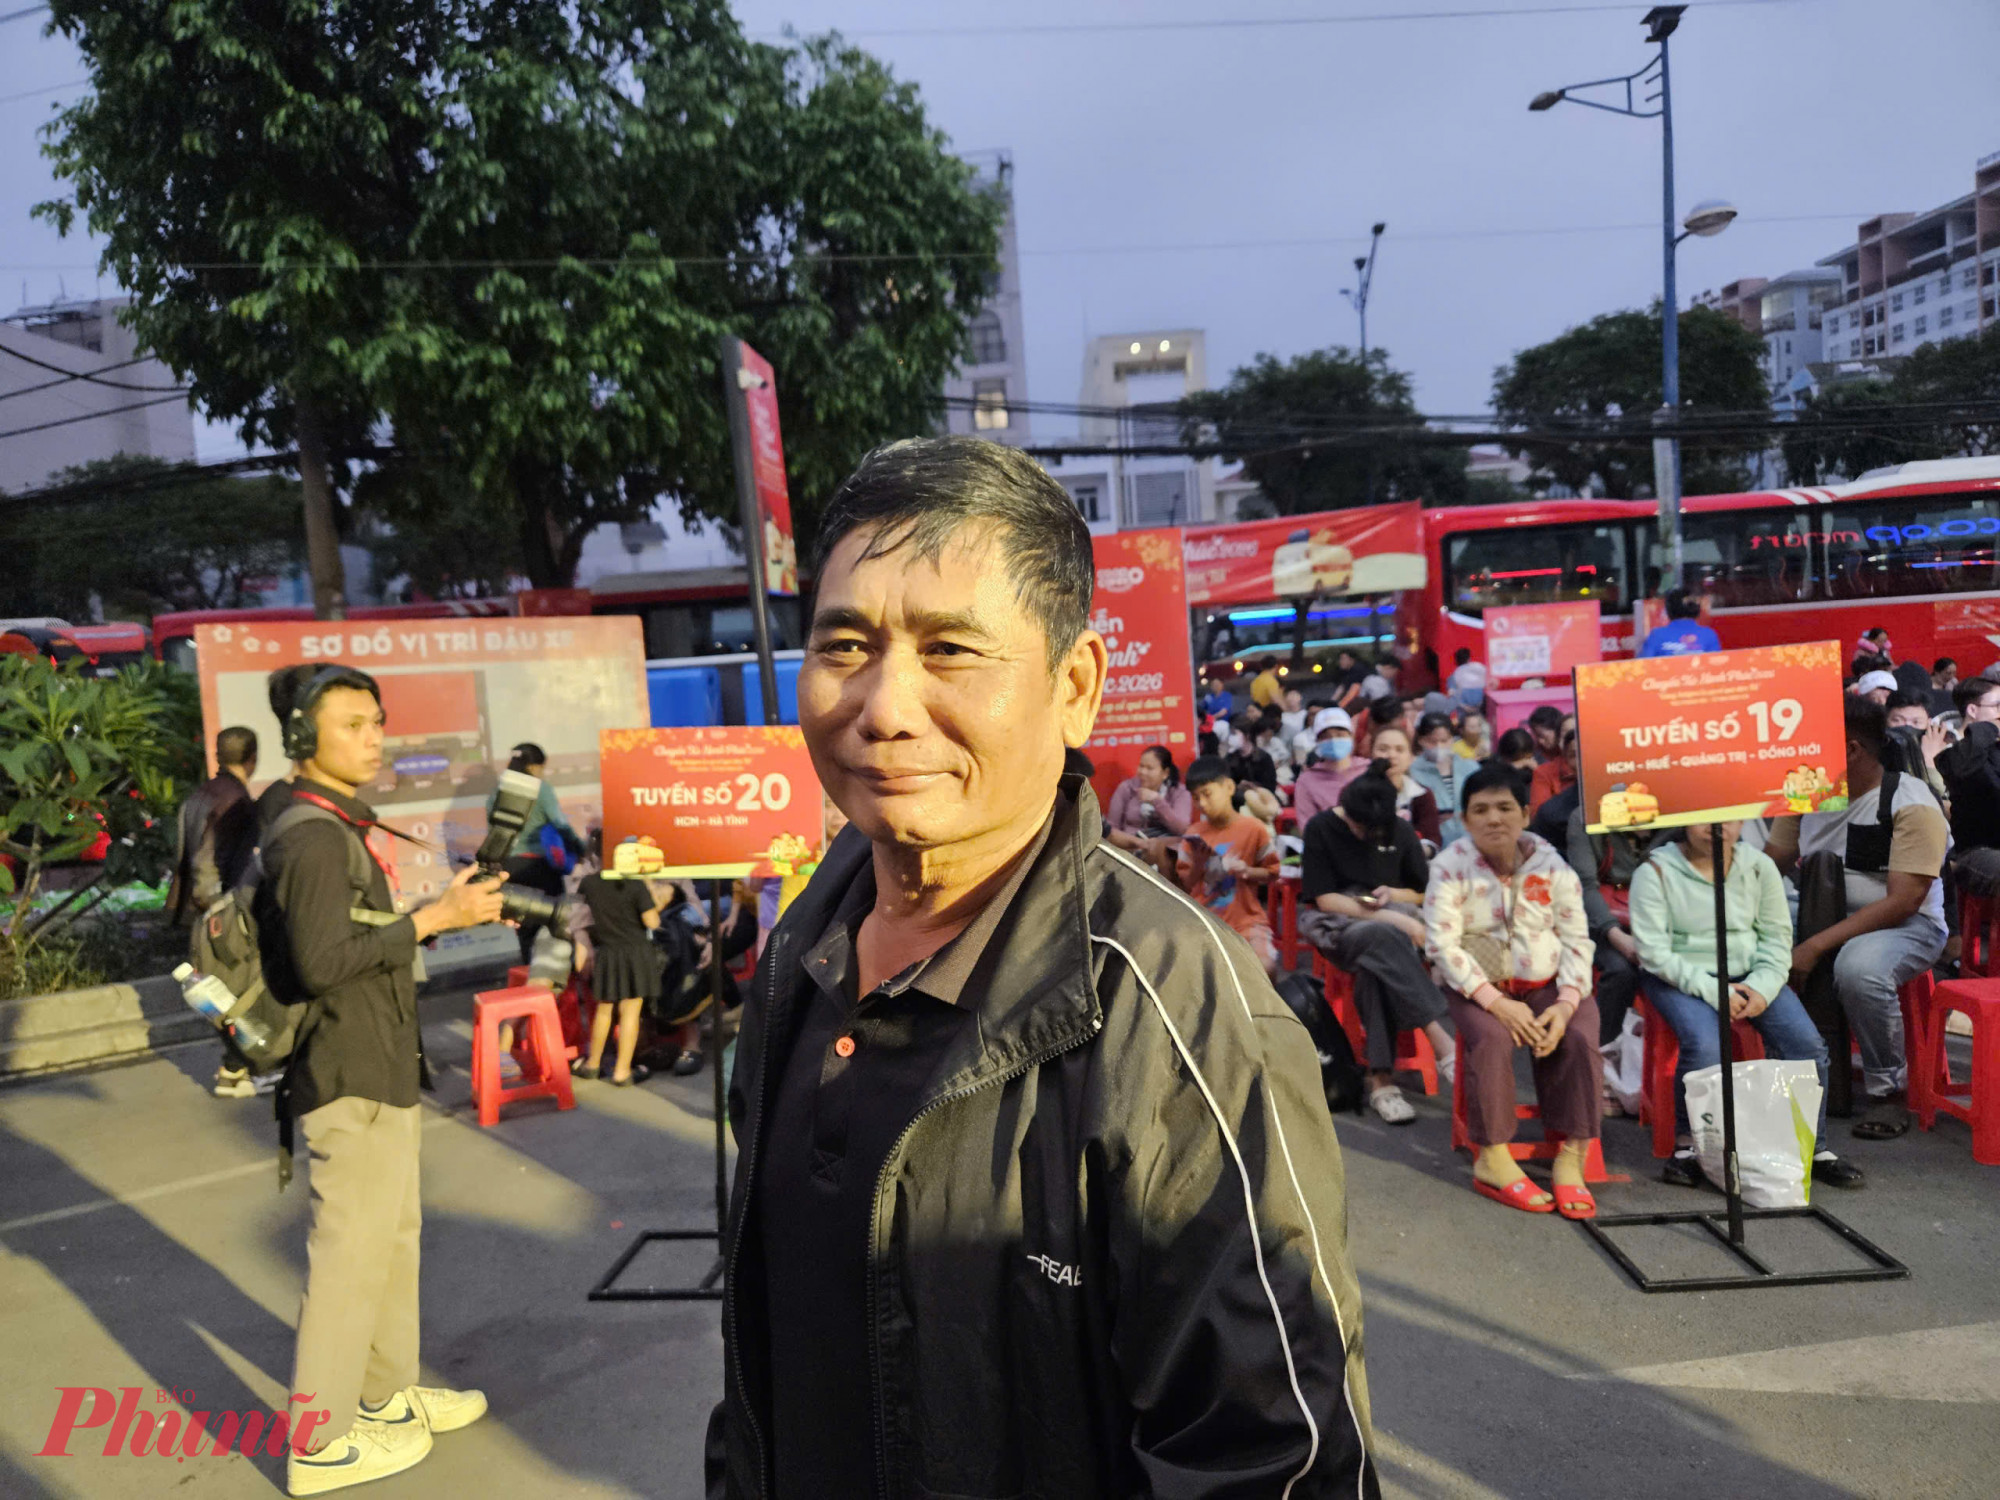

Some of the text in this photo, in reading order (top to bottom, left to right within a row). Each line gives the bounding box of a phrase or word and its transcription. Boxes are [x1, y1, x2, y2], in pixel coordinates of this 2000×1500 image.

[300, 633, 343, 659] SƠ
[400, 632, 428, 658] VỊ
[434, 627, 478, 652] TRÍ
[1620, 698, 1803, 748] TUYẾN SỐ 19
[1606, 761, 1636, 774] HCM
[1645, 755, 1670, 771] HUẾ
[1680, 750, 1726, 768] QUẢNG
[1728, 751, 1747, 765] TRỊ
[631, 772, 791, 811] TUYẾN SỐ 20
[674, 816, 699, 826] HCM
